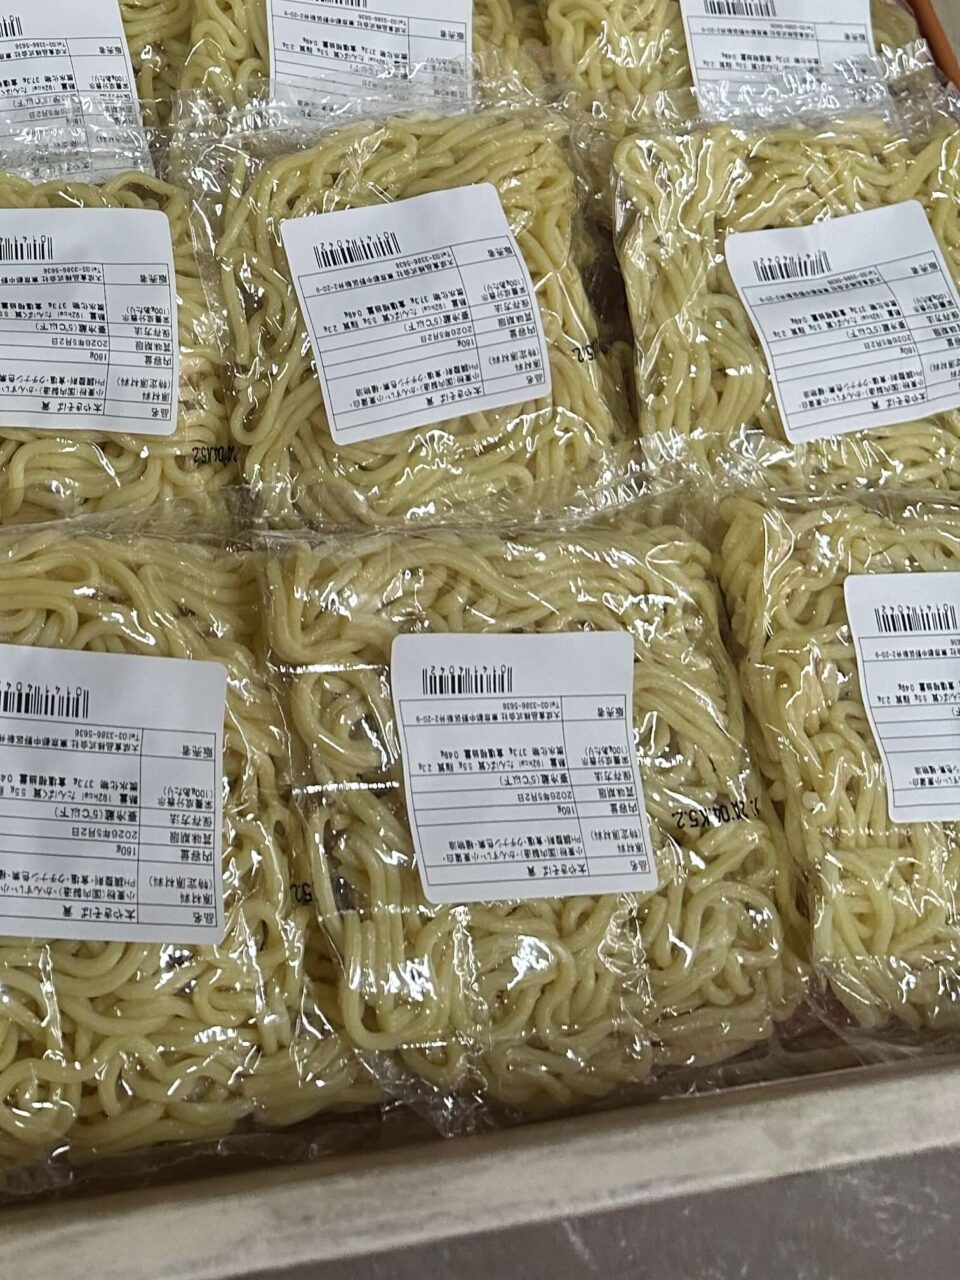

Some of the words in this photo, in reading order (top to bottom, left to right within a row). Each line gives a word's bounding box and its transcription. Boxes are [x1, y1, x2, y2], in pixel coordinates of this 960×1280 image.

[72, 740, 139, 752] 大成食品株式会社
[182, 745, 213, 757] 販売者
[169, 814, 212, 826] 保存方法
[72, 827, 137, 839] 2026年5月2日
[169, 831, 212, 843] 賞味期限
[116, 844, 136, 856] 160g
[180, 850, 212, 862] 内容量
[180, 892, 213, 903] 原材料
[63, 905, 72, 917] 黄
[81, 907, 135, 919] 太やきそば
[193, 912, 214, 923] 品名
